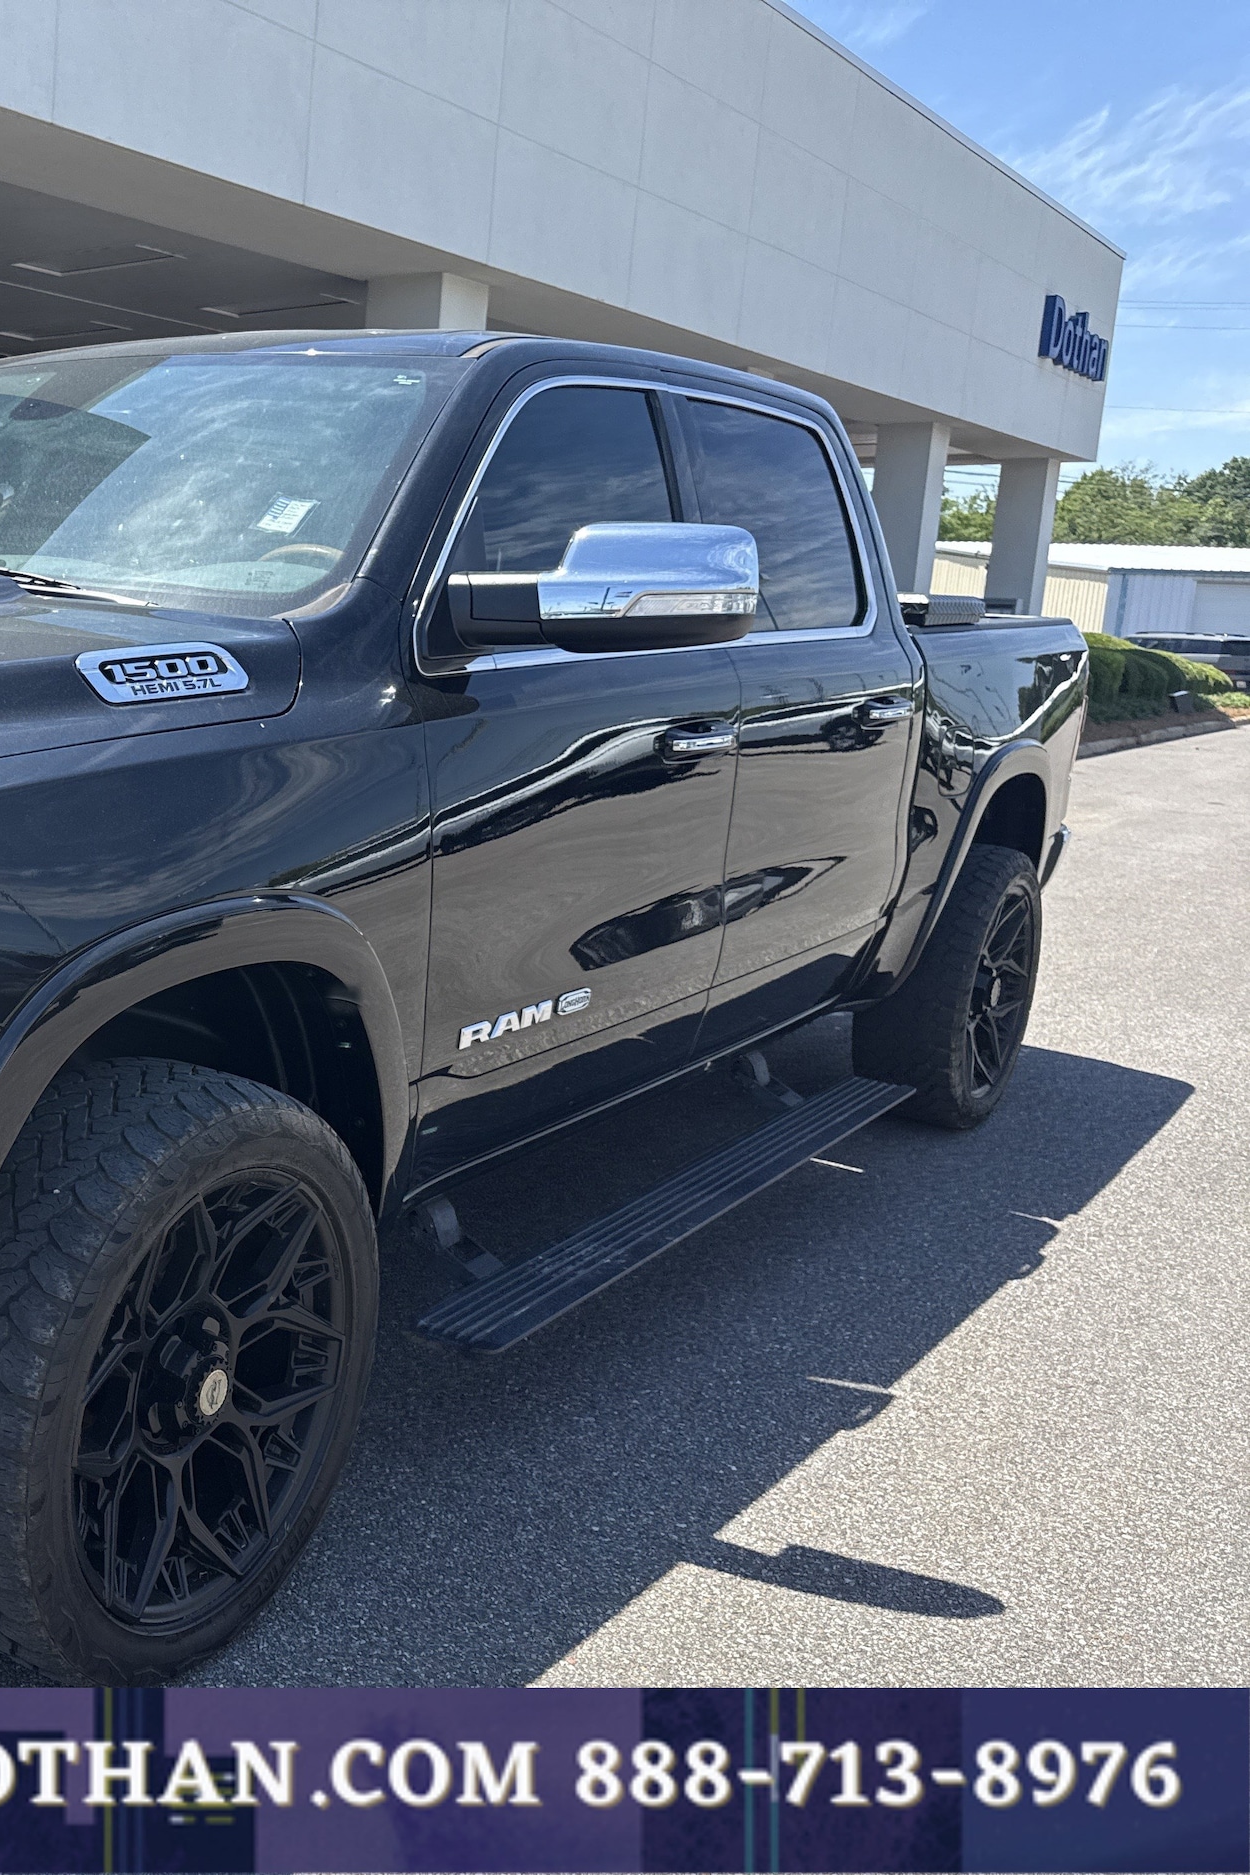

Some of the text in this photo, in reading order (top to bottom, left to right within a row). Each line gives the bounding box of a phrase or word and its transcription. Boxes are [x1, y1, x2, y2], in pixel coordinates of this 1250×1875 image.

[1039, 294, 1108, 382] Dothan
[104, 655, 219, 684] 1500
[131, 678, 222, 696] HEMI 5.7L
[458, 999, 553, 1050] RAM
